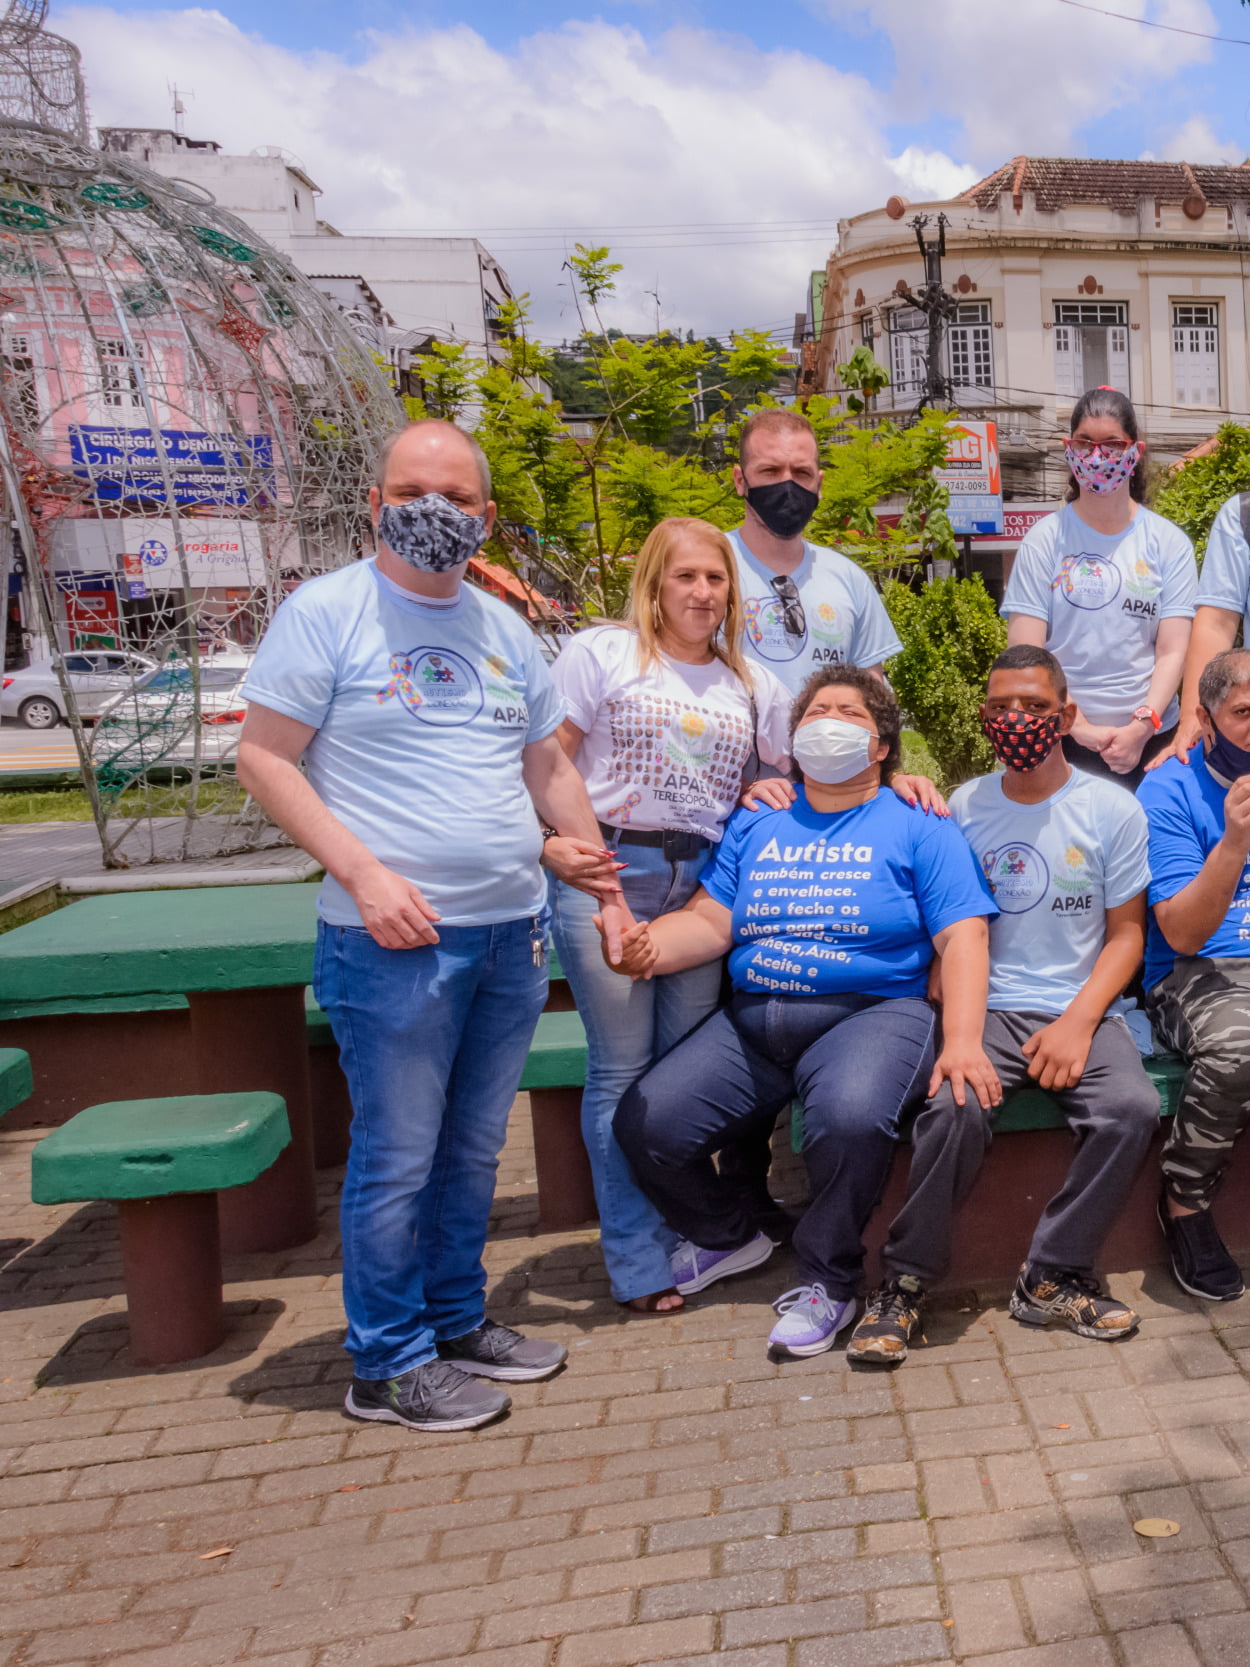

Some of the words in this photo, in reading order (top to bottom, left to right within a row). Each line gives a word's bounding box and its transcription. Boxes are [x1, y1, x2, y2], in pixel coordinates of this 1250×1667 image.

[89, 433, 173, 450] CIRURGIO
[1121, 598, 1157, 617] APAE
[664, 773, 708, 794] APAE
[756, 837, 873, 863] Autista
[749, 867, 814, 881] também
[820, 870, 872, 880] cresce
[753, 888, 763, 898] e
[767, 885, 857, 897] envelhece.
[746, 902, 781, 917] Não
[787, 902, 835, 915] feche
[840, 904, 860, 915] os
[1051, 895, 1093, 912] APAE
[740, 922, 780, 936] olhos
[831, 922, 870, 935] esta
[751, 951, 803, 975] Aceite
[807, 966, 818, 977] e
[746, 967, 817, 993] Respeite.
